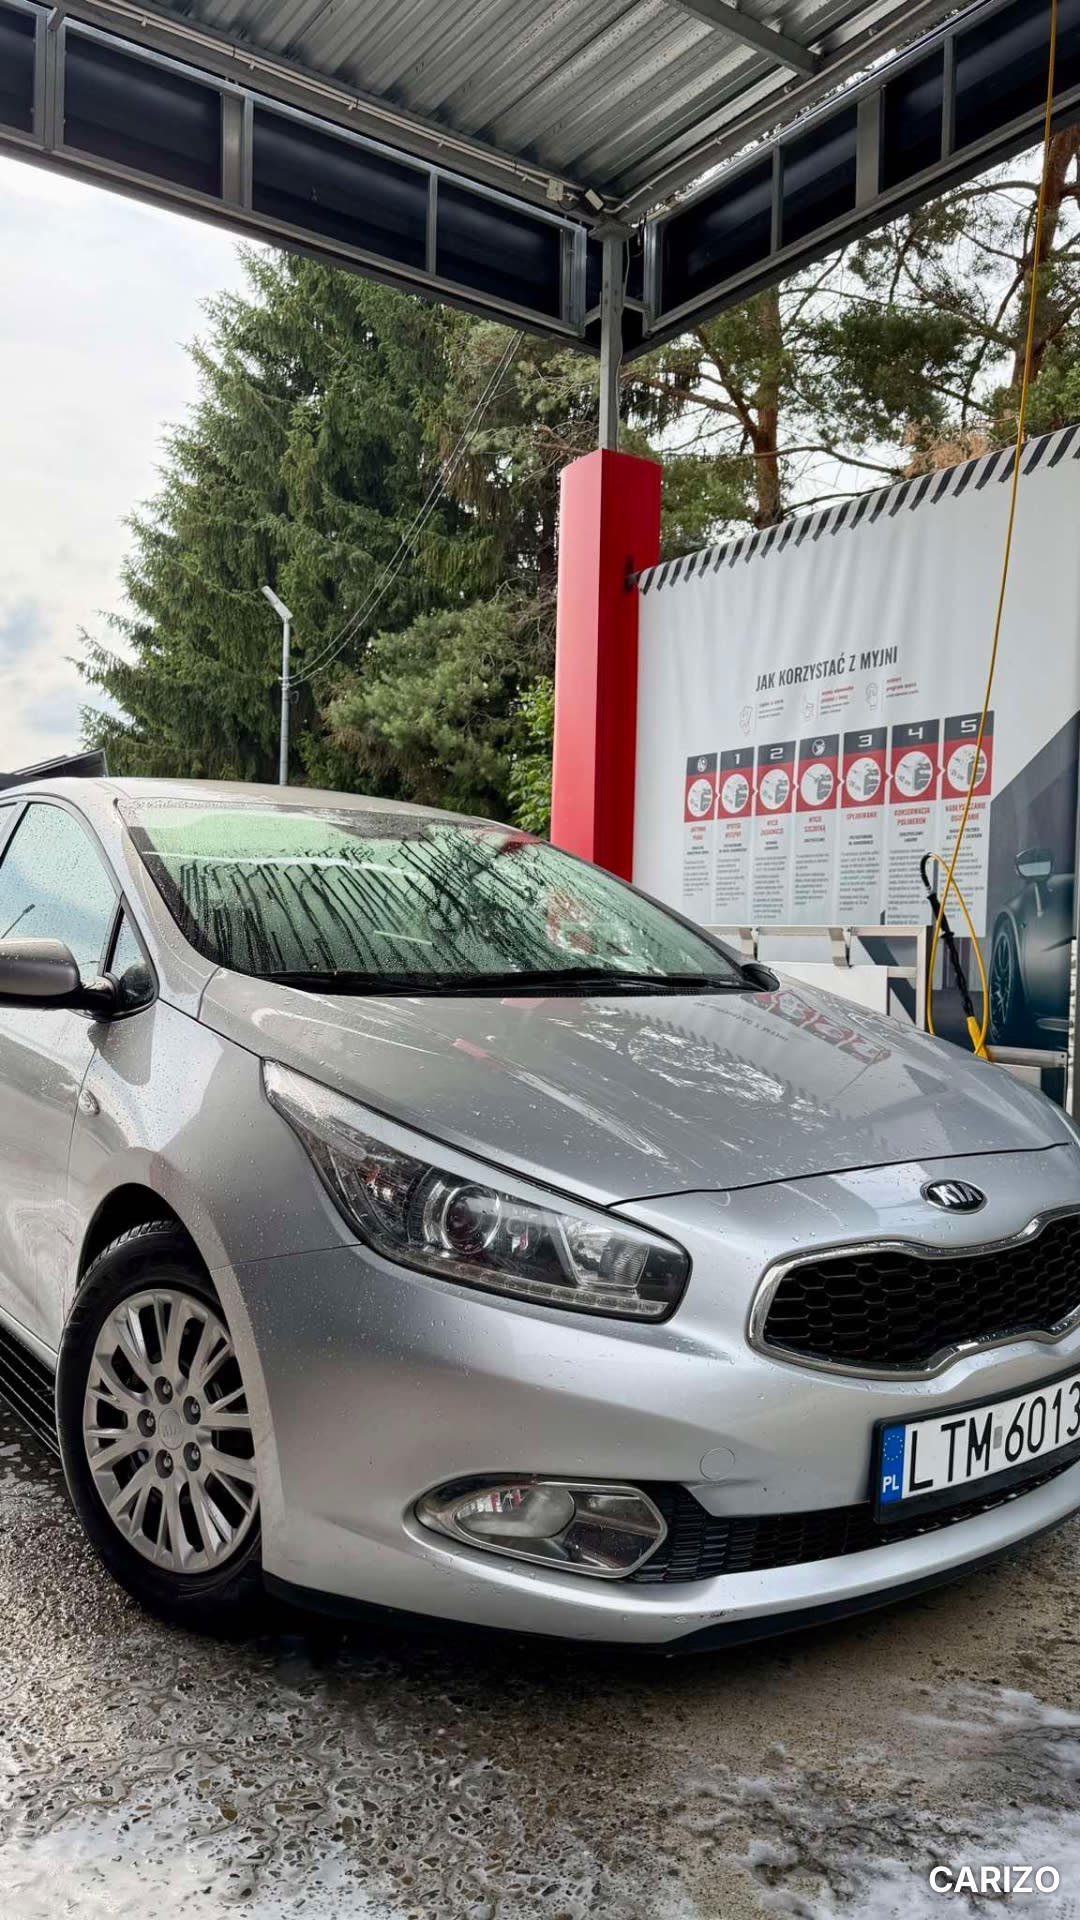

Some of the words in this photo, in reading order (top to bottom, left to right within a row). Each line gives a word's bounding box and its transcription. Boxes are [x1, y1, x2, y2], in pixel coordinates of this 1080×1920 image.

[755, 671, 776, 692] JAK
[779, 652, 846, 686] KORZYSTAĆ
[849, 655, 856, 672] Z
[860, 646, 898, 670] MYJNI
[908, 726, 924, 739] 4
[960, 718, 977, 733] 5
[858, 734, 873, 748] 3
[735, 753, 740, 765] 1
[770, 747, 784, 760] 2
[929, 1183, 982, 1206] KIA
[908, 1412, 993, 1493] LTM
[1005, 1381, 1080, 1462] 6013
[882, 1476, 899, 1493] PL
